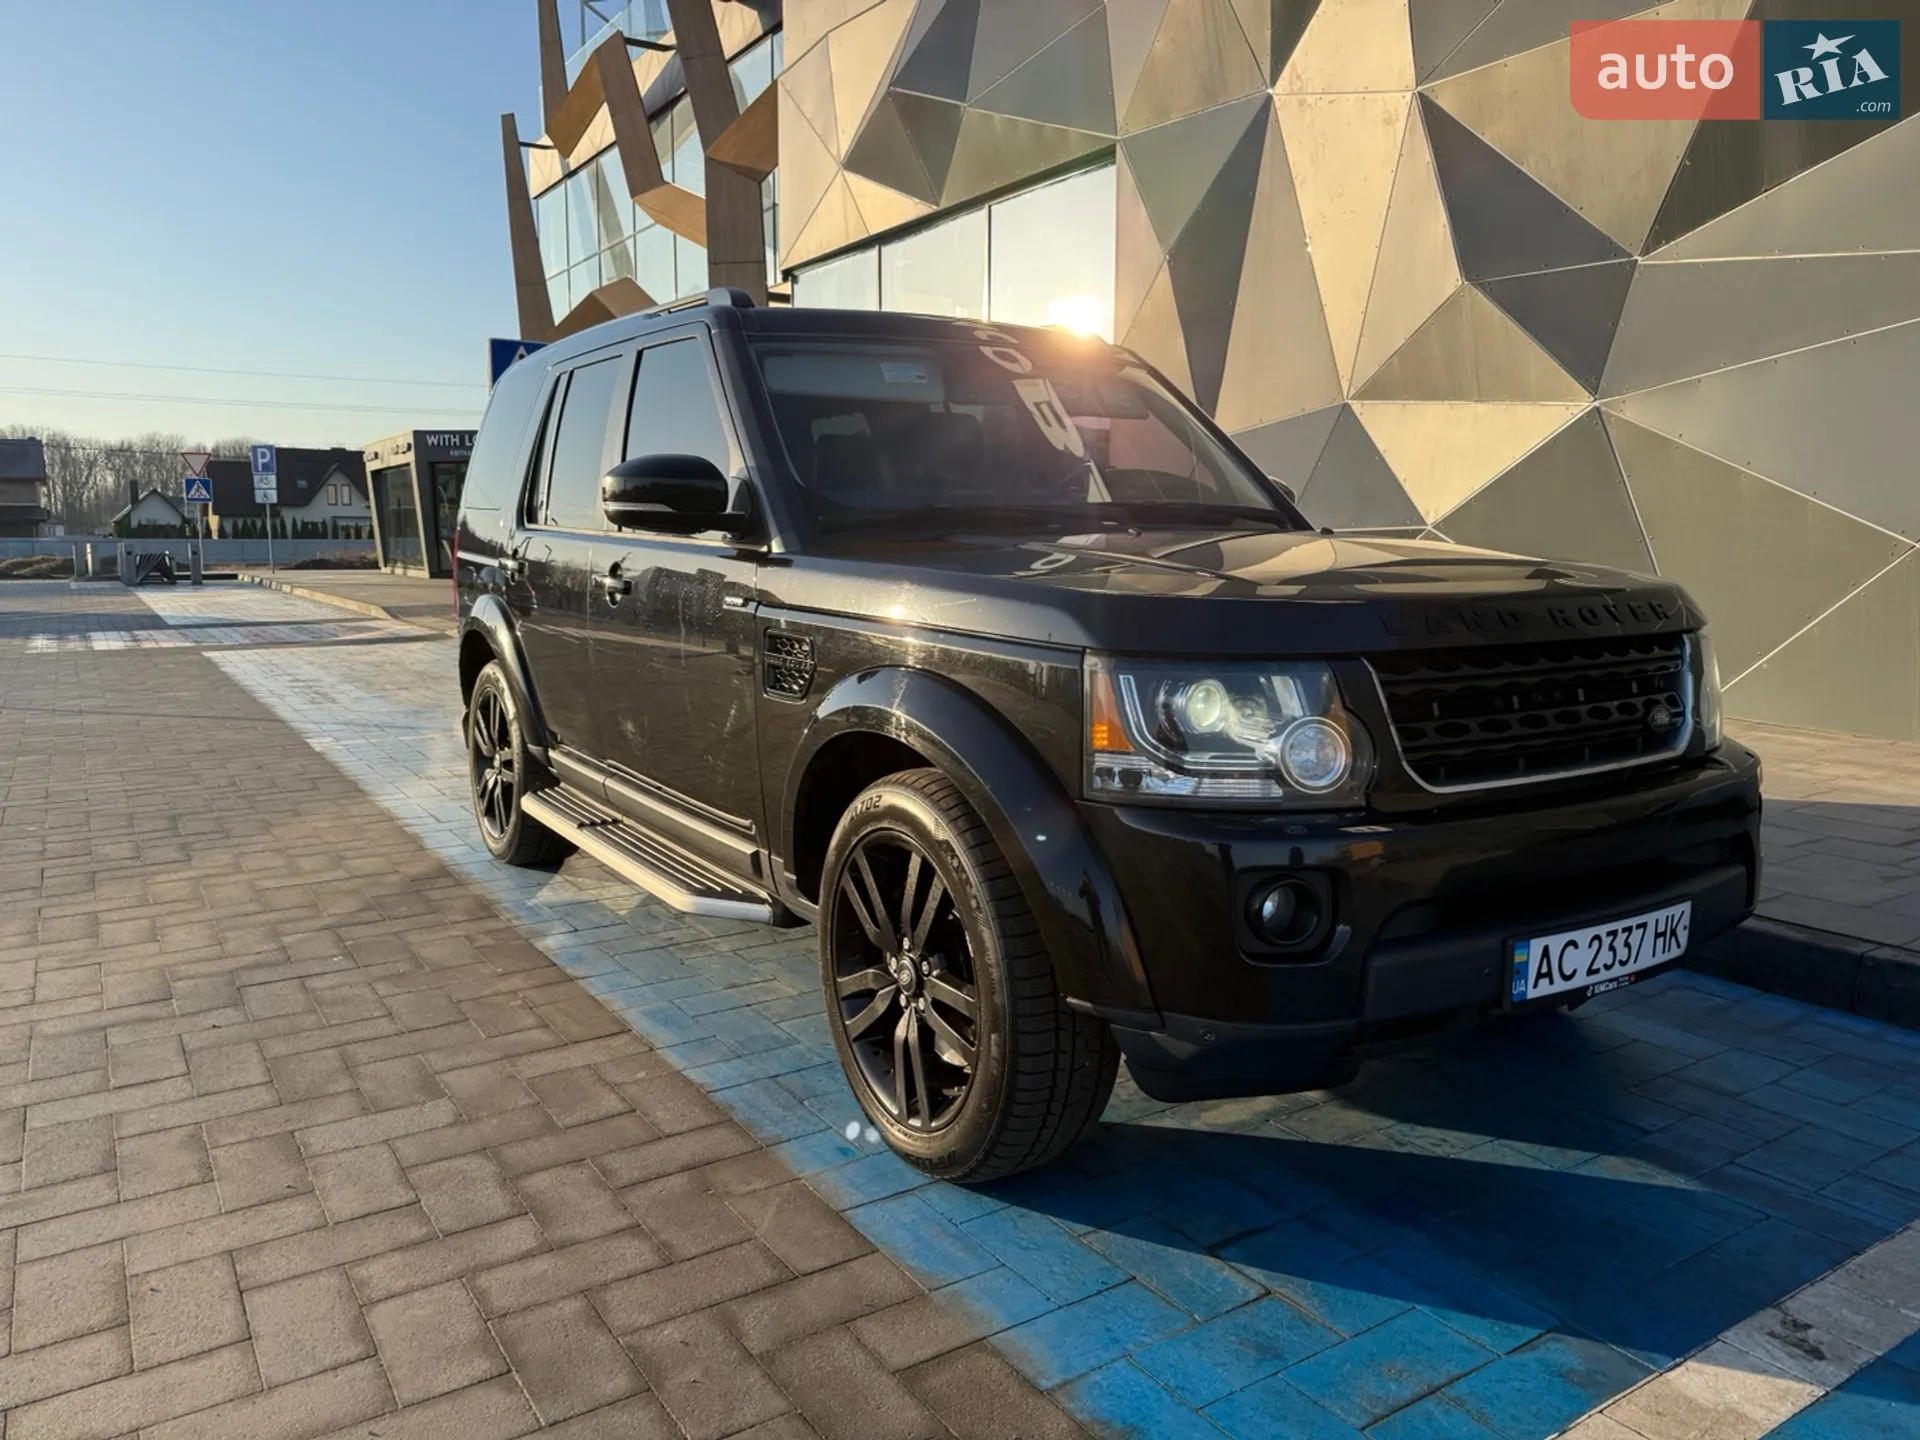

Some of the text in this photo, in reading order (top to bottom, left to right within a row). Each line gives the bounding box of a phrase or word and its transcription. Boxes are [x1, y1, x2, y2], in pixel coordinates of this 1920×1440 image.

[425, 434, 460, 447] WITH
[257, 448, 271, 472] P
[1379, 600, 1673, 637] LAND ROVER
[1532, 910, 1686, 990] AC 2337 HK
[1511, 978, 1527, 995] UA
